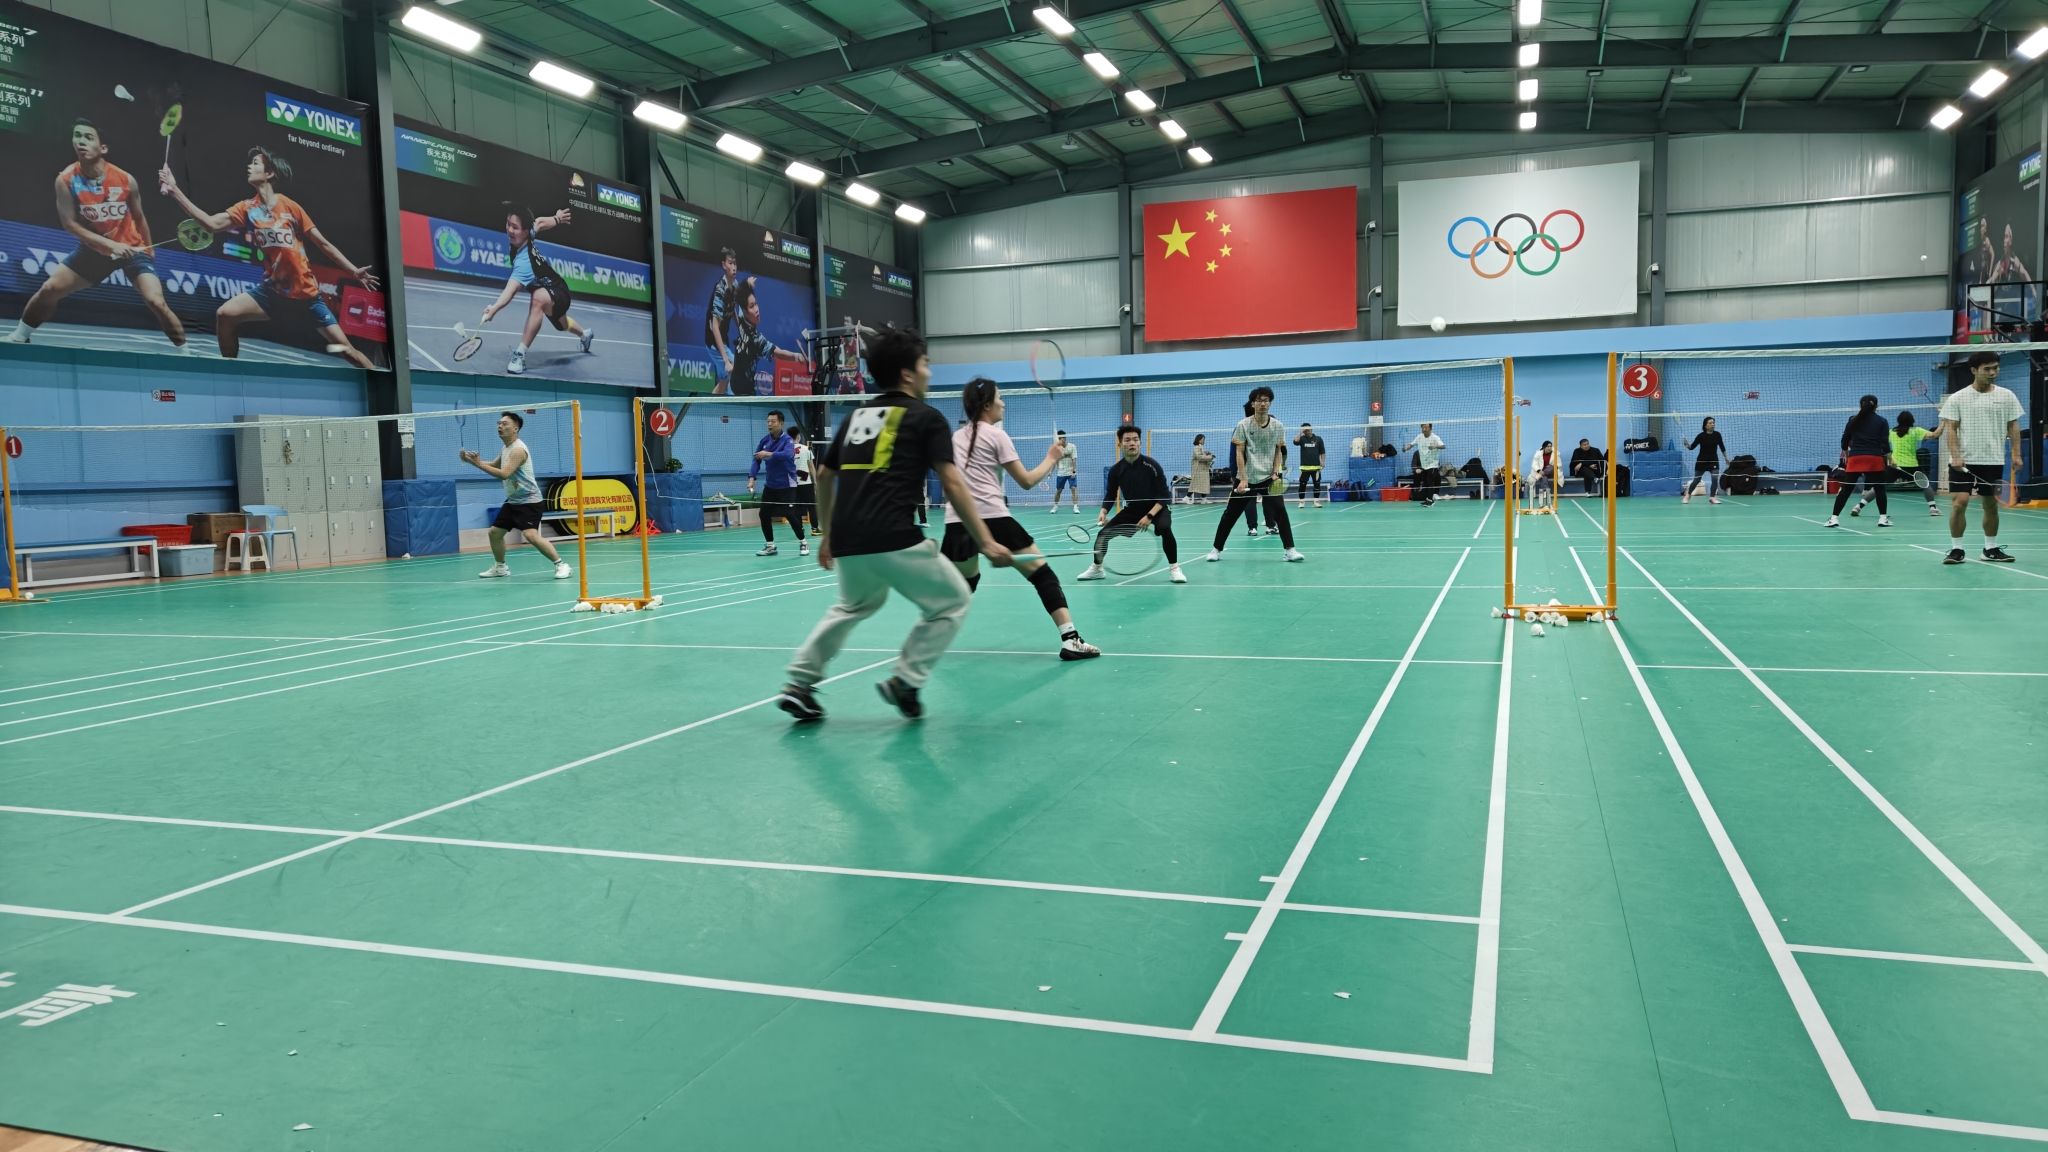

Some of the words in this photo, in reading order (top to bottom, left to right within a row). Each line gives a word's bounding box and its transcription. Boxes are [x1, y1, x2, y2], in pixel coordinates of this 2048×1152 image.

[304, 108, 356, 140] YONEX
[288, 133, 298, 142] far
[298, 137, 320, 148] beyond
[321, 143, 345, 156] ordinary
[615, 191, 639, 208] YONEX
[267, 230, 293, 245] SCG
[549, 257, 587, 281] YONEX
[612, 270, 646, 292] YONEX
[678, 359, 712, 379] YONEX
[1629, 367, 1648, 392] 3
[656, 411, 669, 432] 2
